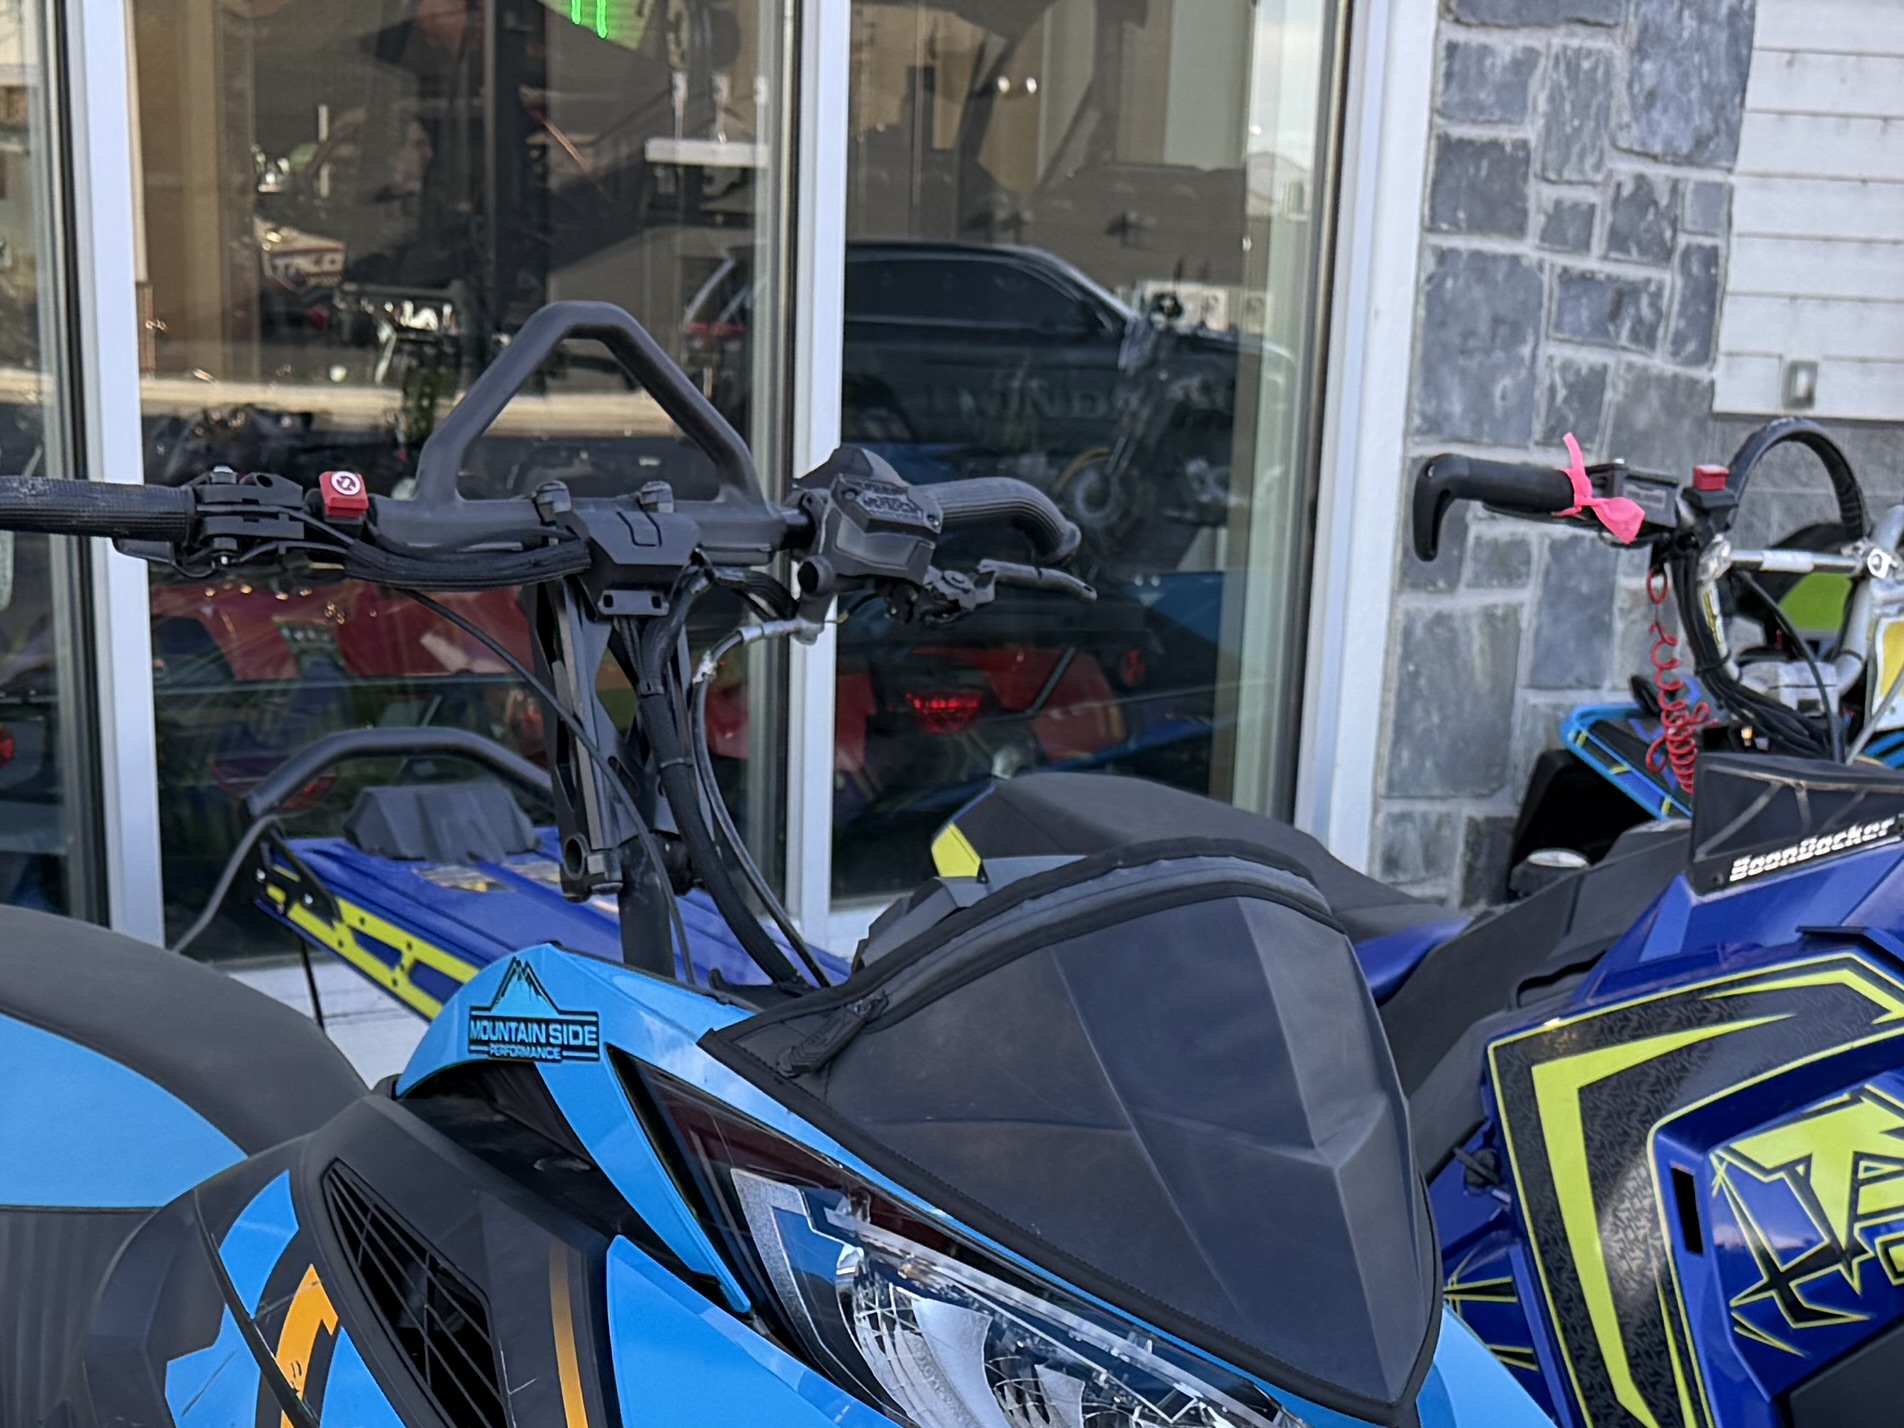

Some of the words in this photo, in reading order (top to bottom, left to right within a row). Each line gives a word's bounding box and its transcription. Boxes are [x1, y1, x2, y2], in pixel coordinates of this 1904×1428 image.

[470, 1020, 546, 1044] MOUNTAIN
[549, 1024, 599, 1047] SIDE
[490, 1044, 562, 1060] PERFORMANCE
